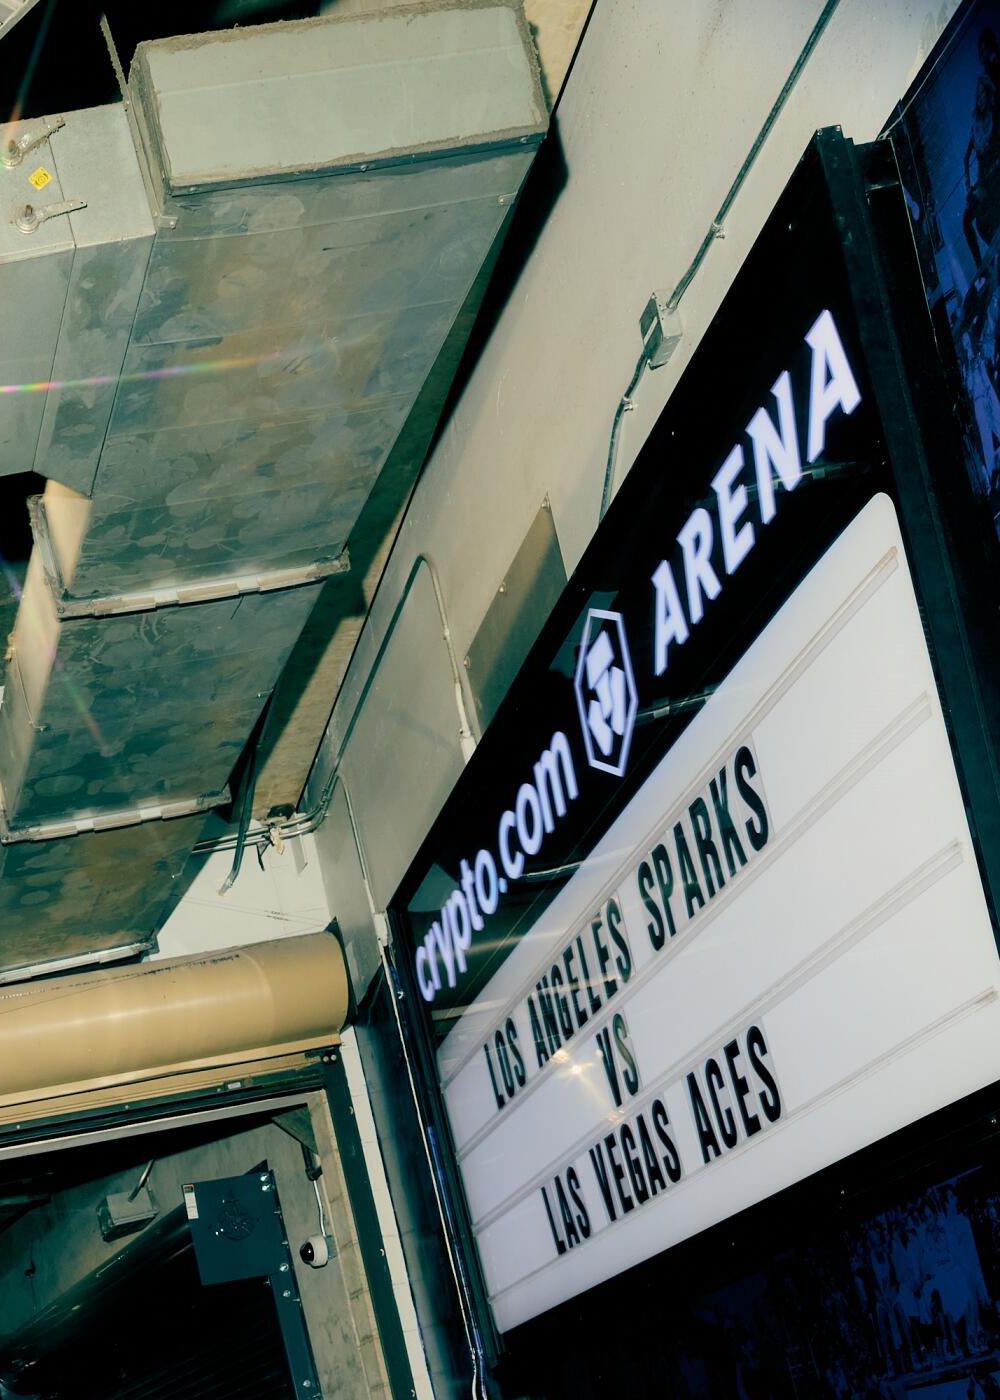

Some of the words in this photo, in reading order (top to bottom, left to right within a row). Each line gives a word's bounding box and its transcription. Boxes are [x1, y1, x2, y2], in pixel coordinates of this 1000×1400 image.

[416, 731, 579, 1002] crypto.com
[651, 309, 861, 677] ARENA
[483, 1016, 527, 1111] LOS
[527, 897, 632, 1069] ANGELES
[637, 745, 769, 951] SPARKS
[595, 1012, 640, 1107] VS
[540, 1165, 592, 1255] LAS
[588, 1098, 682, 1222] VEGAS
[686, 1025, 782, 1165] ACES
